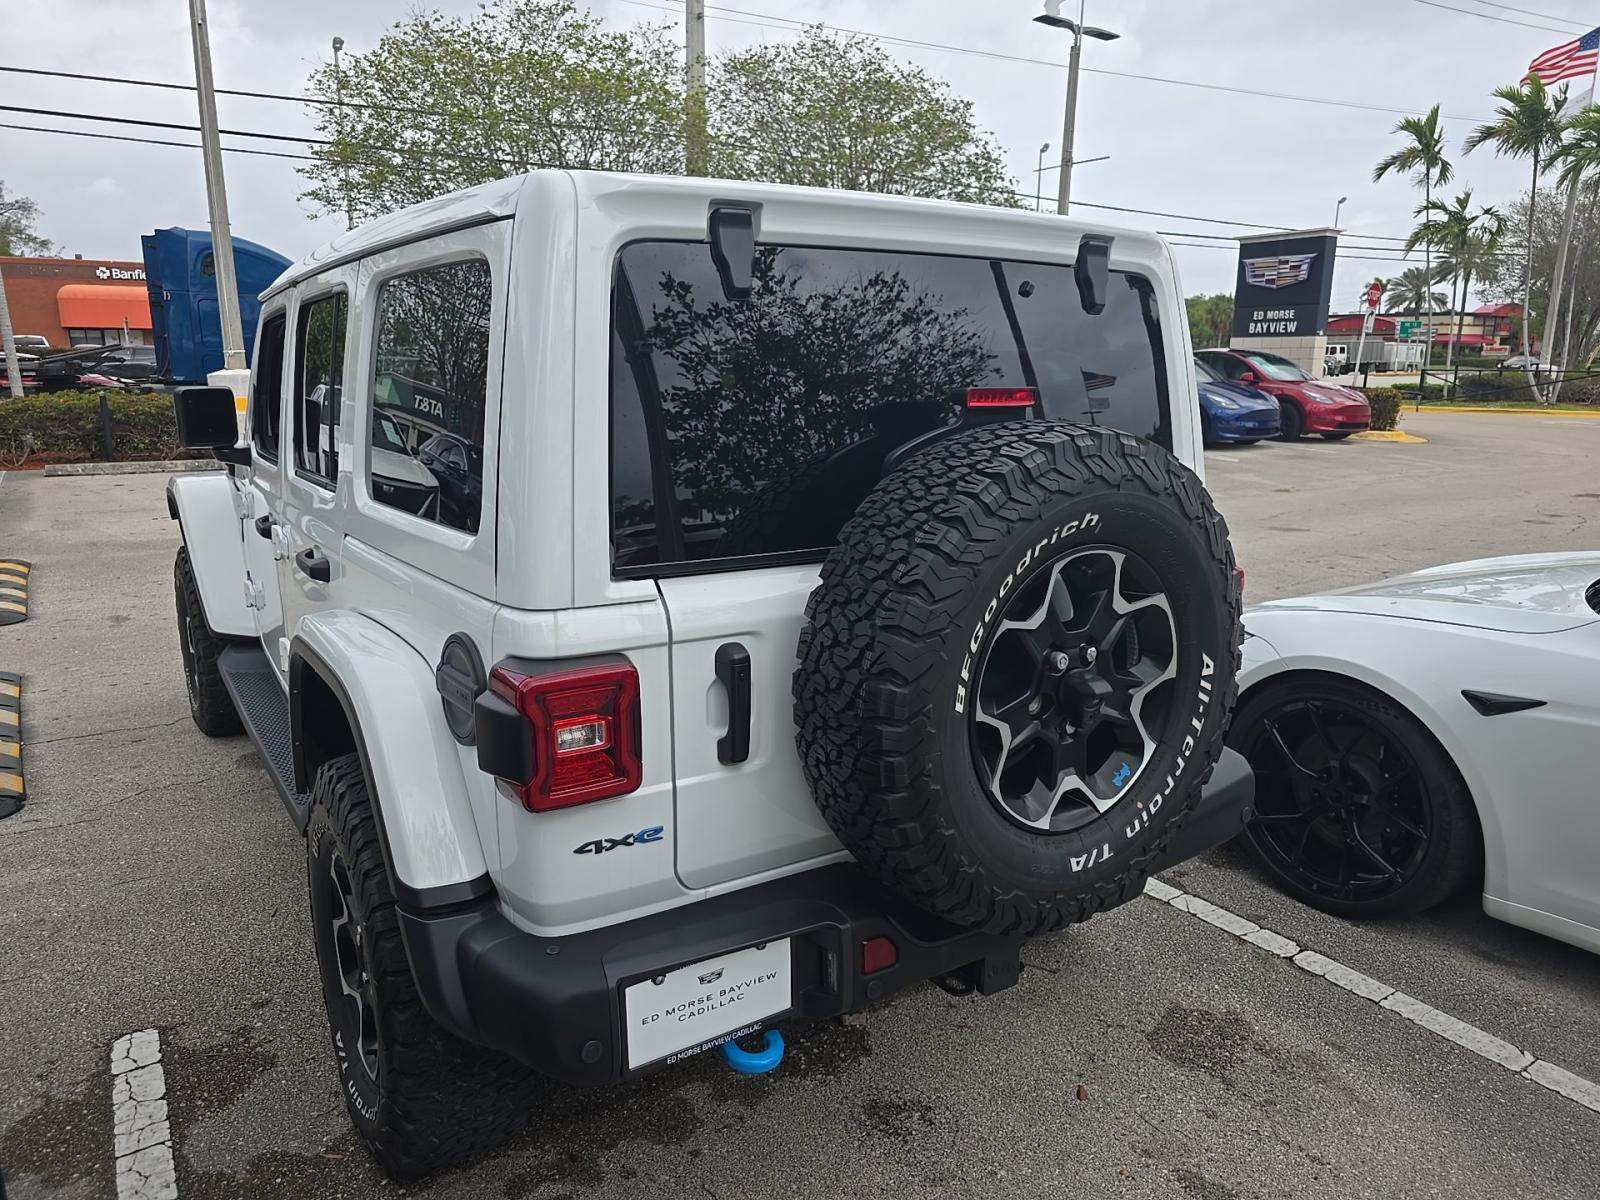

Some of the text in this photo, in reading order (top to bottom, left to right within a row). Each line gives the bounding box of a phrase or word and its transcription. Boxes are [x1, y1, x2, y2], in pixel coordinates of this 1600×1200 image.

[1248, 321, 1298, 334] BAYVIEW
[1253, 309, 1296, 320] ED MORSE
[954, 512, 1100, 714] BFGoodrich
[1069, 652, 1215, 873] All-Terrain T/A
[641, 971, 778, 1026] ED MORSE BAYVIEW
[678, 992, 746, 1022] CADILLAC
[667, 1022, 762, 1065] ED MORSE BAYVIEW CADILLAC
